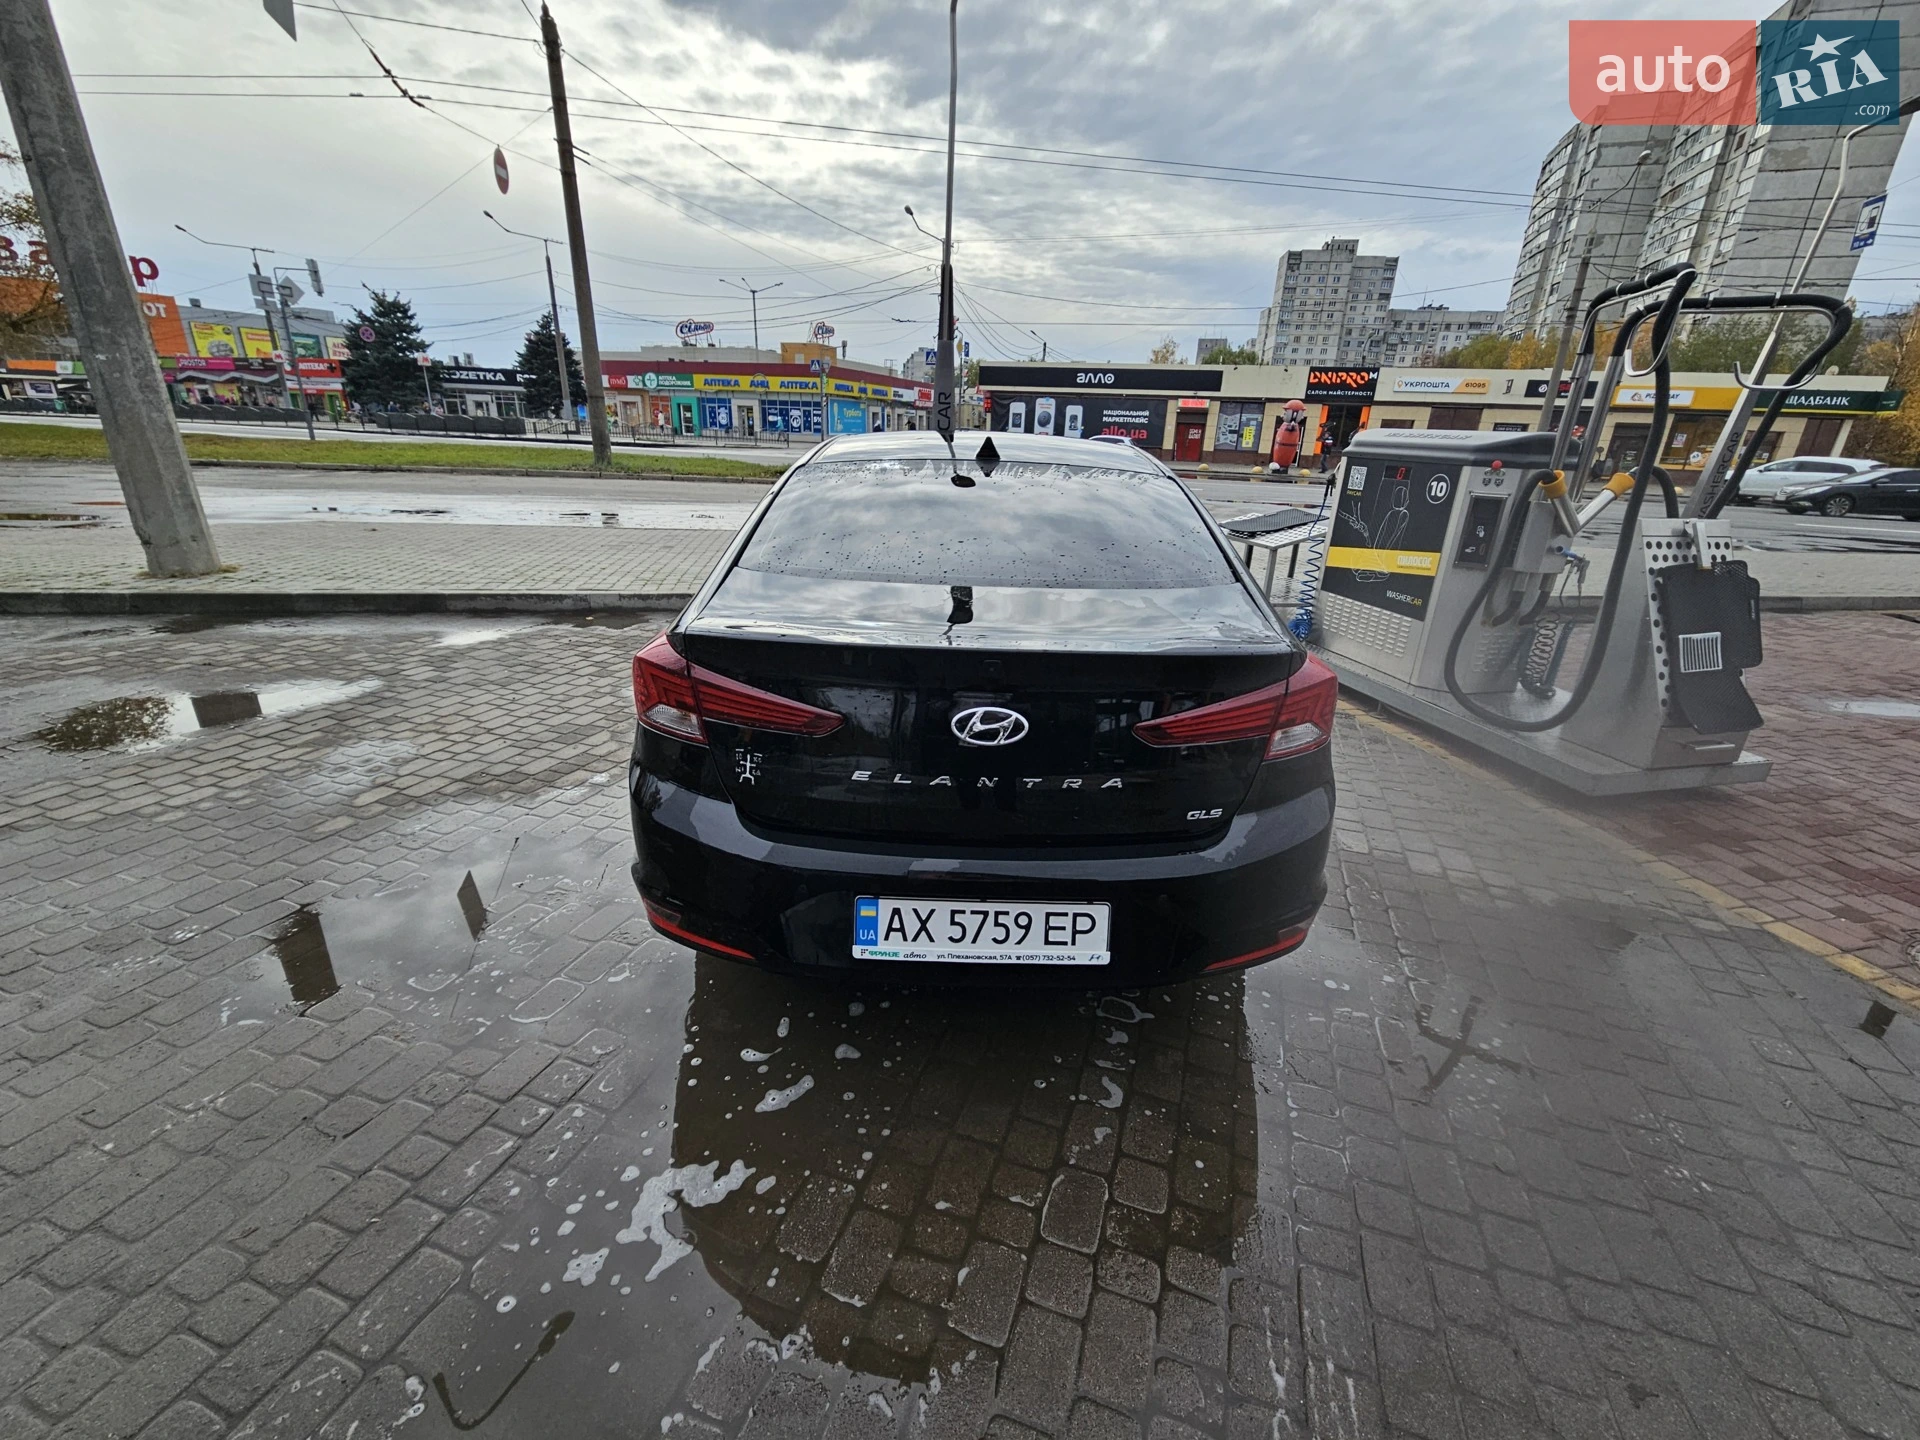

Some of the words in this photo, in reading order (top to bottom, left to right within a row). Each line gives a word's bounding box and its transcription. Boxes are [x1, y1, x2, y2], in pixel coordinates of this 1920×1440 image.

[703, 378, 740, 387] АПТЕКА
[749, 379, 770, 390] АНЦ
[779, 380, 818, 390] АПТЕКА
[1404, 381, 1450, 389] УКРПОШТА
[1785, 395, 1851, 406] ЩАДБАНК
[1103, 409, 1150, 417] НАЦІОНАЛЬНИЙ
[1102, 416, 1149, 424] МАРКЕТПЛЕЙС
[1101, 425, 1148, 439] allo.ua
[1430, 480, 1447, 497] 10
[1386, 589, 1423, 607] WASHERCAR
[851, 770, 1124, 789] ELANTRA
[1186, 808, 1223, 820] GLS
[883, 907, 937, 943] AX
[947, 909, 1033, 945] 5759
[1043, 911, 1097, 946] EP
[859, 929, 876, 940] UA
[903, 951, 927, 959] авто
[947, 953, 999, 961] Плехановская,
[1042, 954, 1076, 962] 732-52-54
